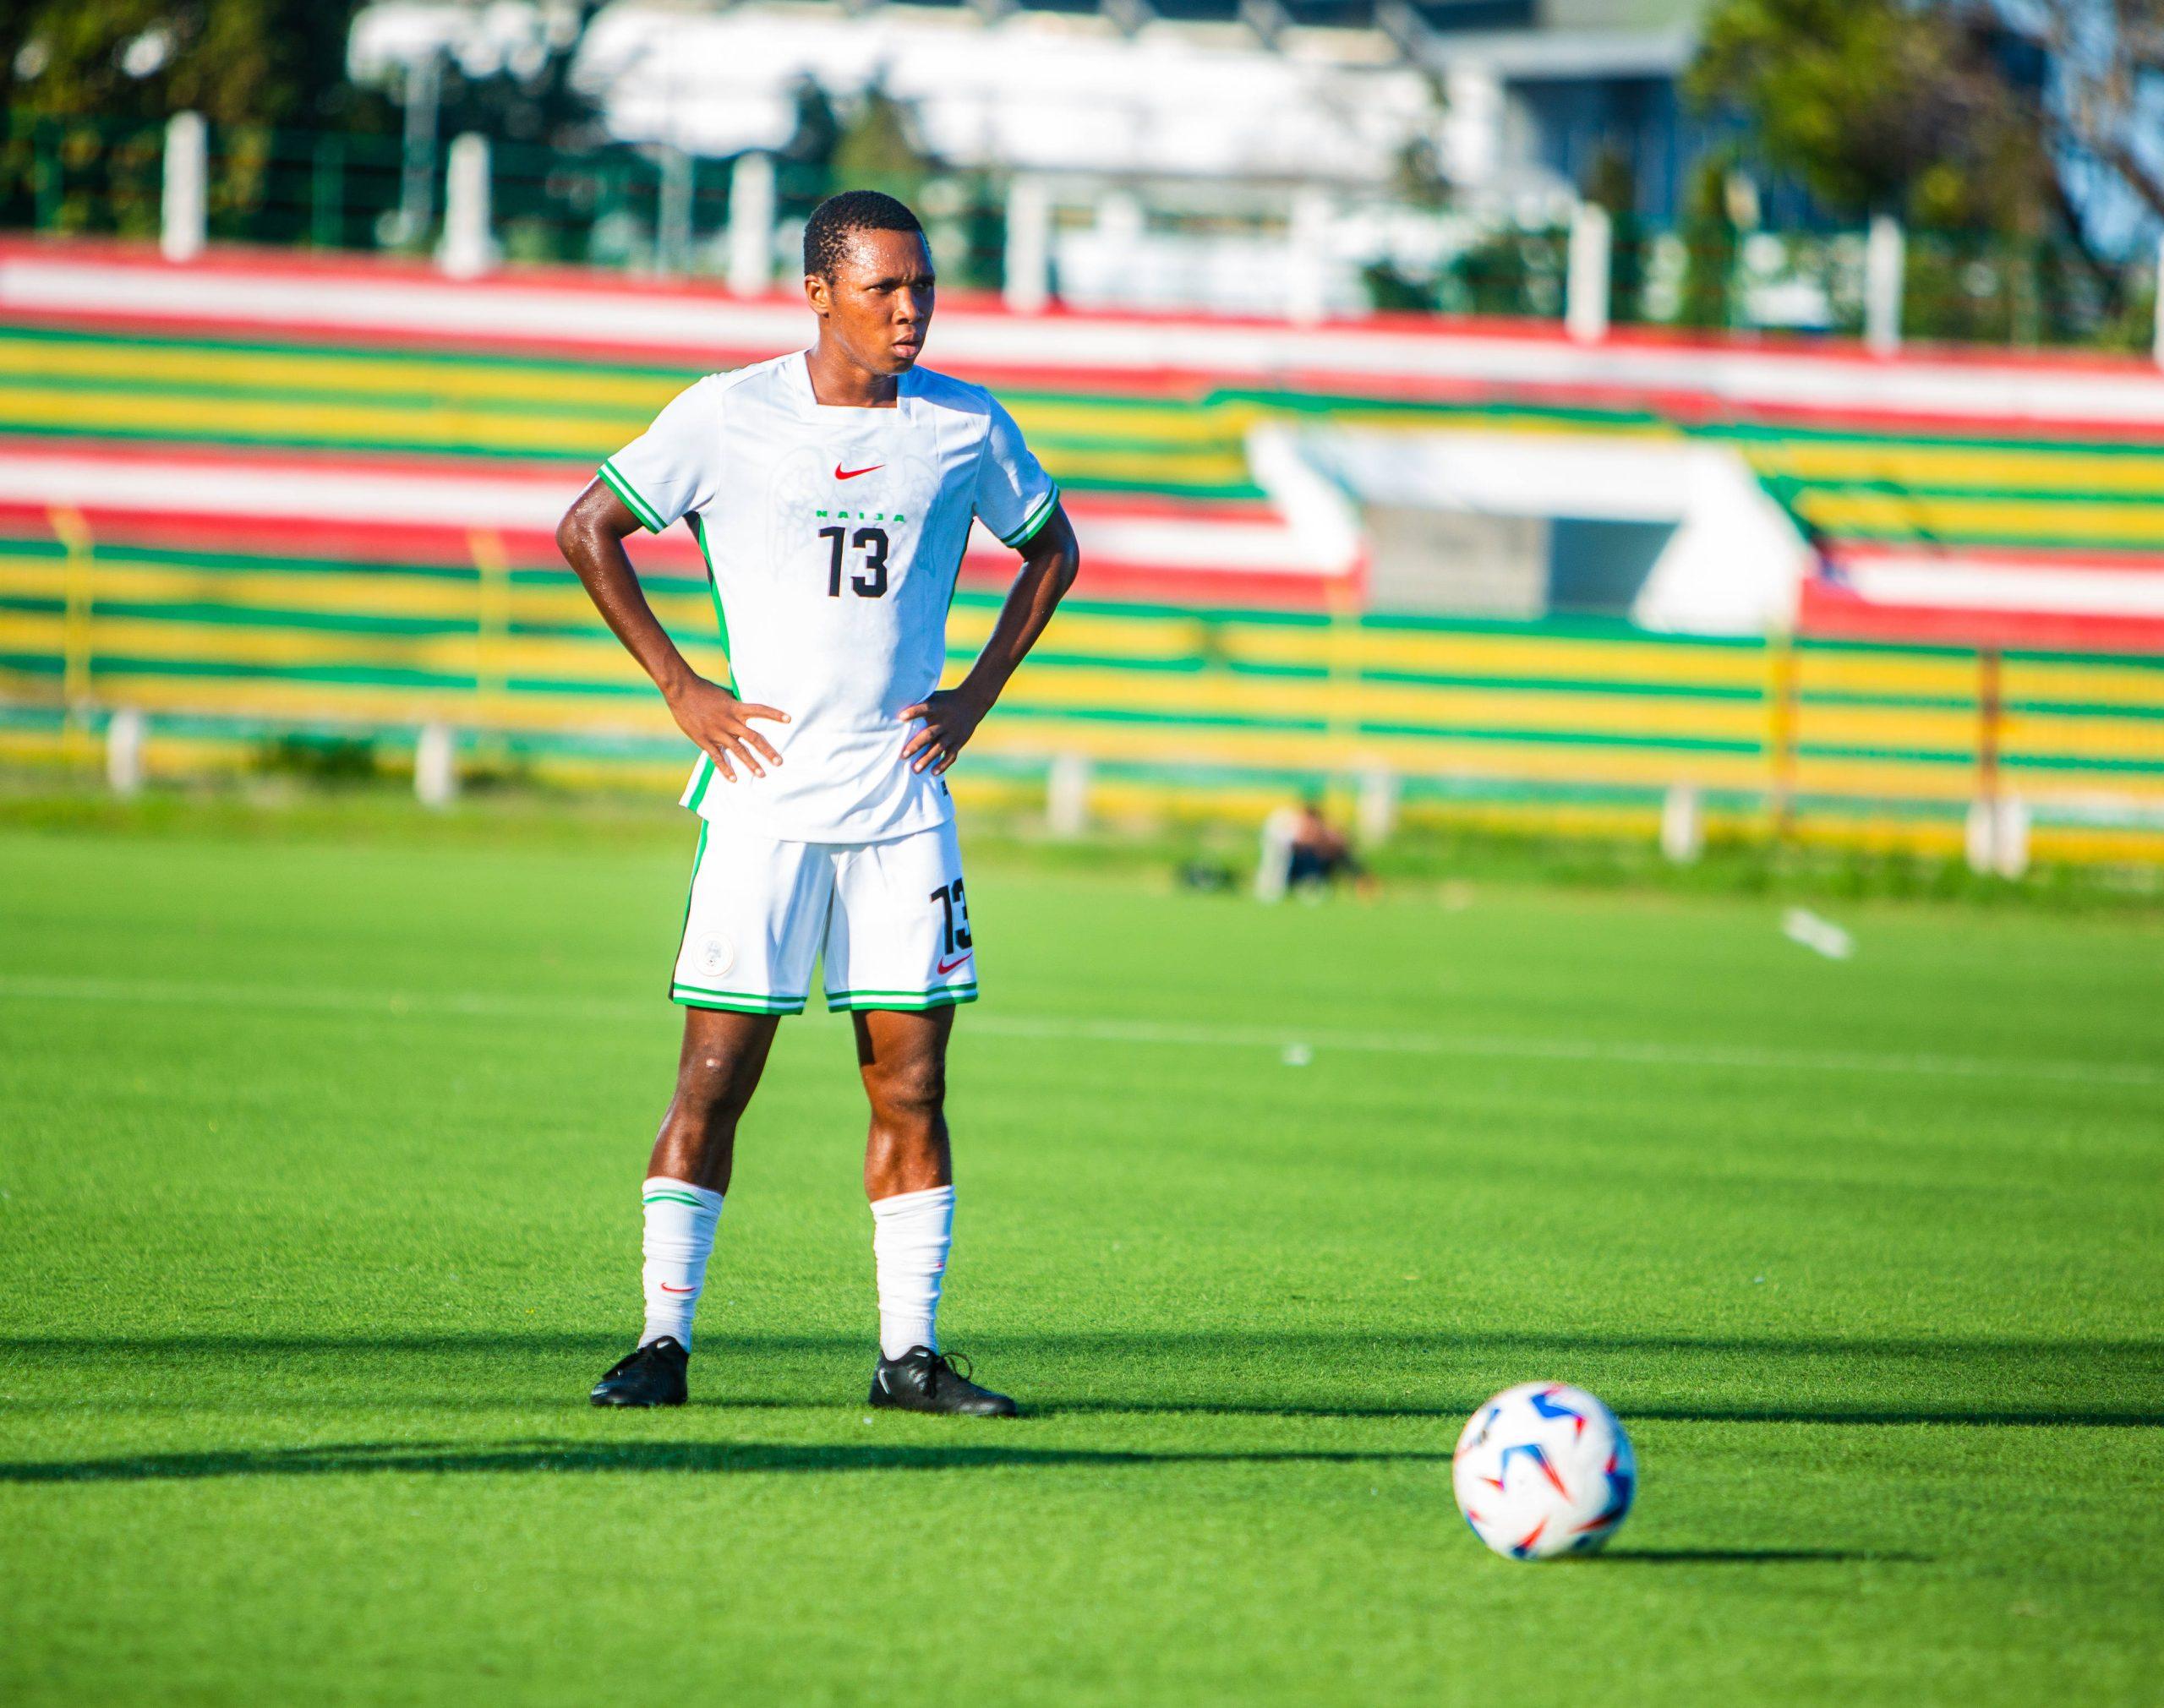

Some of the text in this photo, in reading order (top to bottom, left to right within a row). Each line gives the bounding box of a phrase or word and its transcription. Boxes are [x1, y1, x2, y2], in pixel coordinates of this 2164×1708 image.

[816, 510, 906, 523] NAIJA
[817, 526, 889, 598] 13
[930, 876, 973, 956] 13
